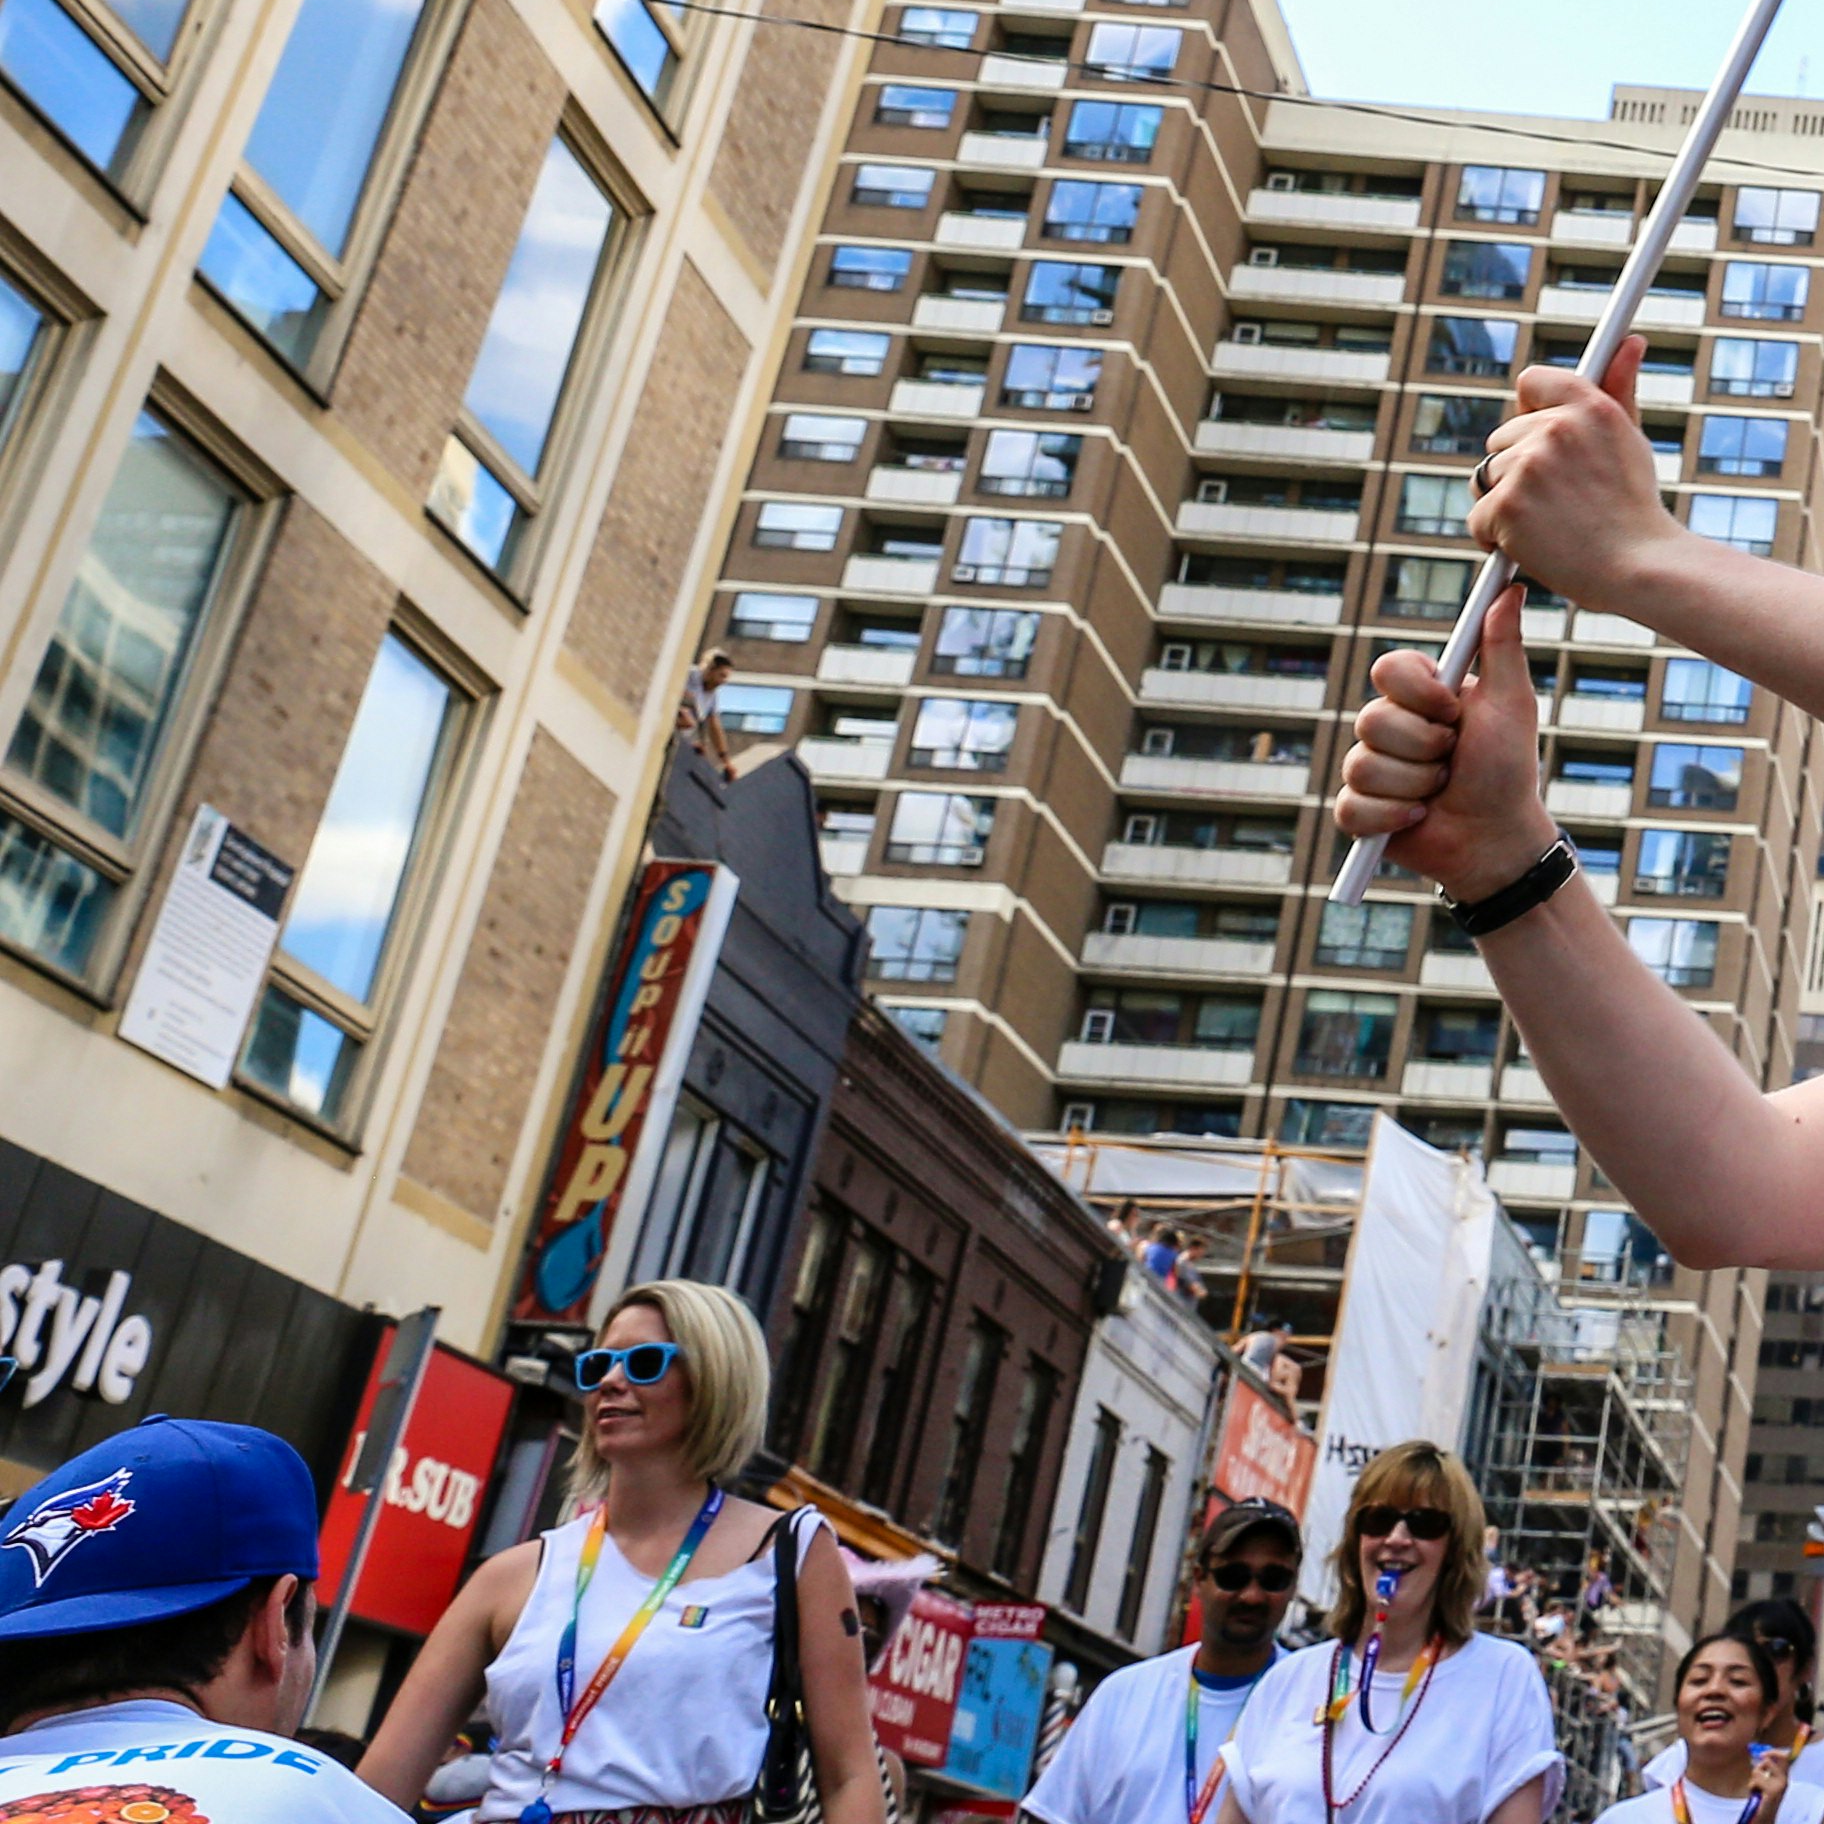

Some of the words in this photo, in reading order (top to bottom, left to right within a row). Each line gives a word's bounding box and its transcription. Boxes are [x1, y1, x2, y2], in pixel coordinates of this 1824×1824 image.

[629, 877, 693, 1016] SOUP
[552, 1063, 655, 1223] UP
[889, 1612, 963, 1705] CIGAR
[974, 1603, 1046, 1622] METRO
[46, 1738, 328, 1776] PRIDE
